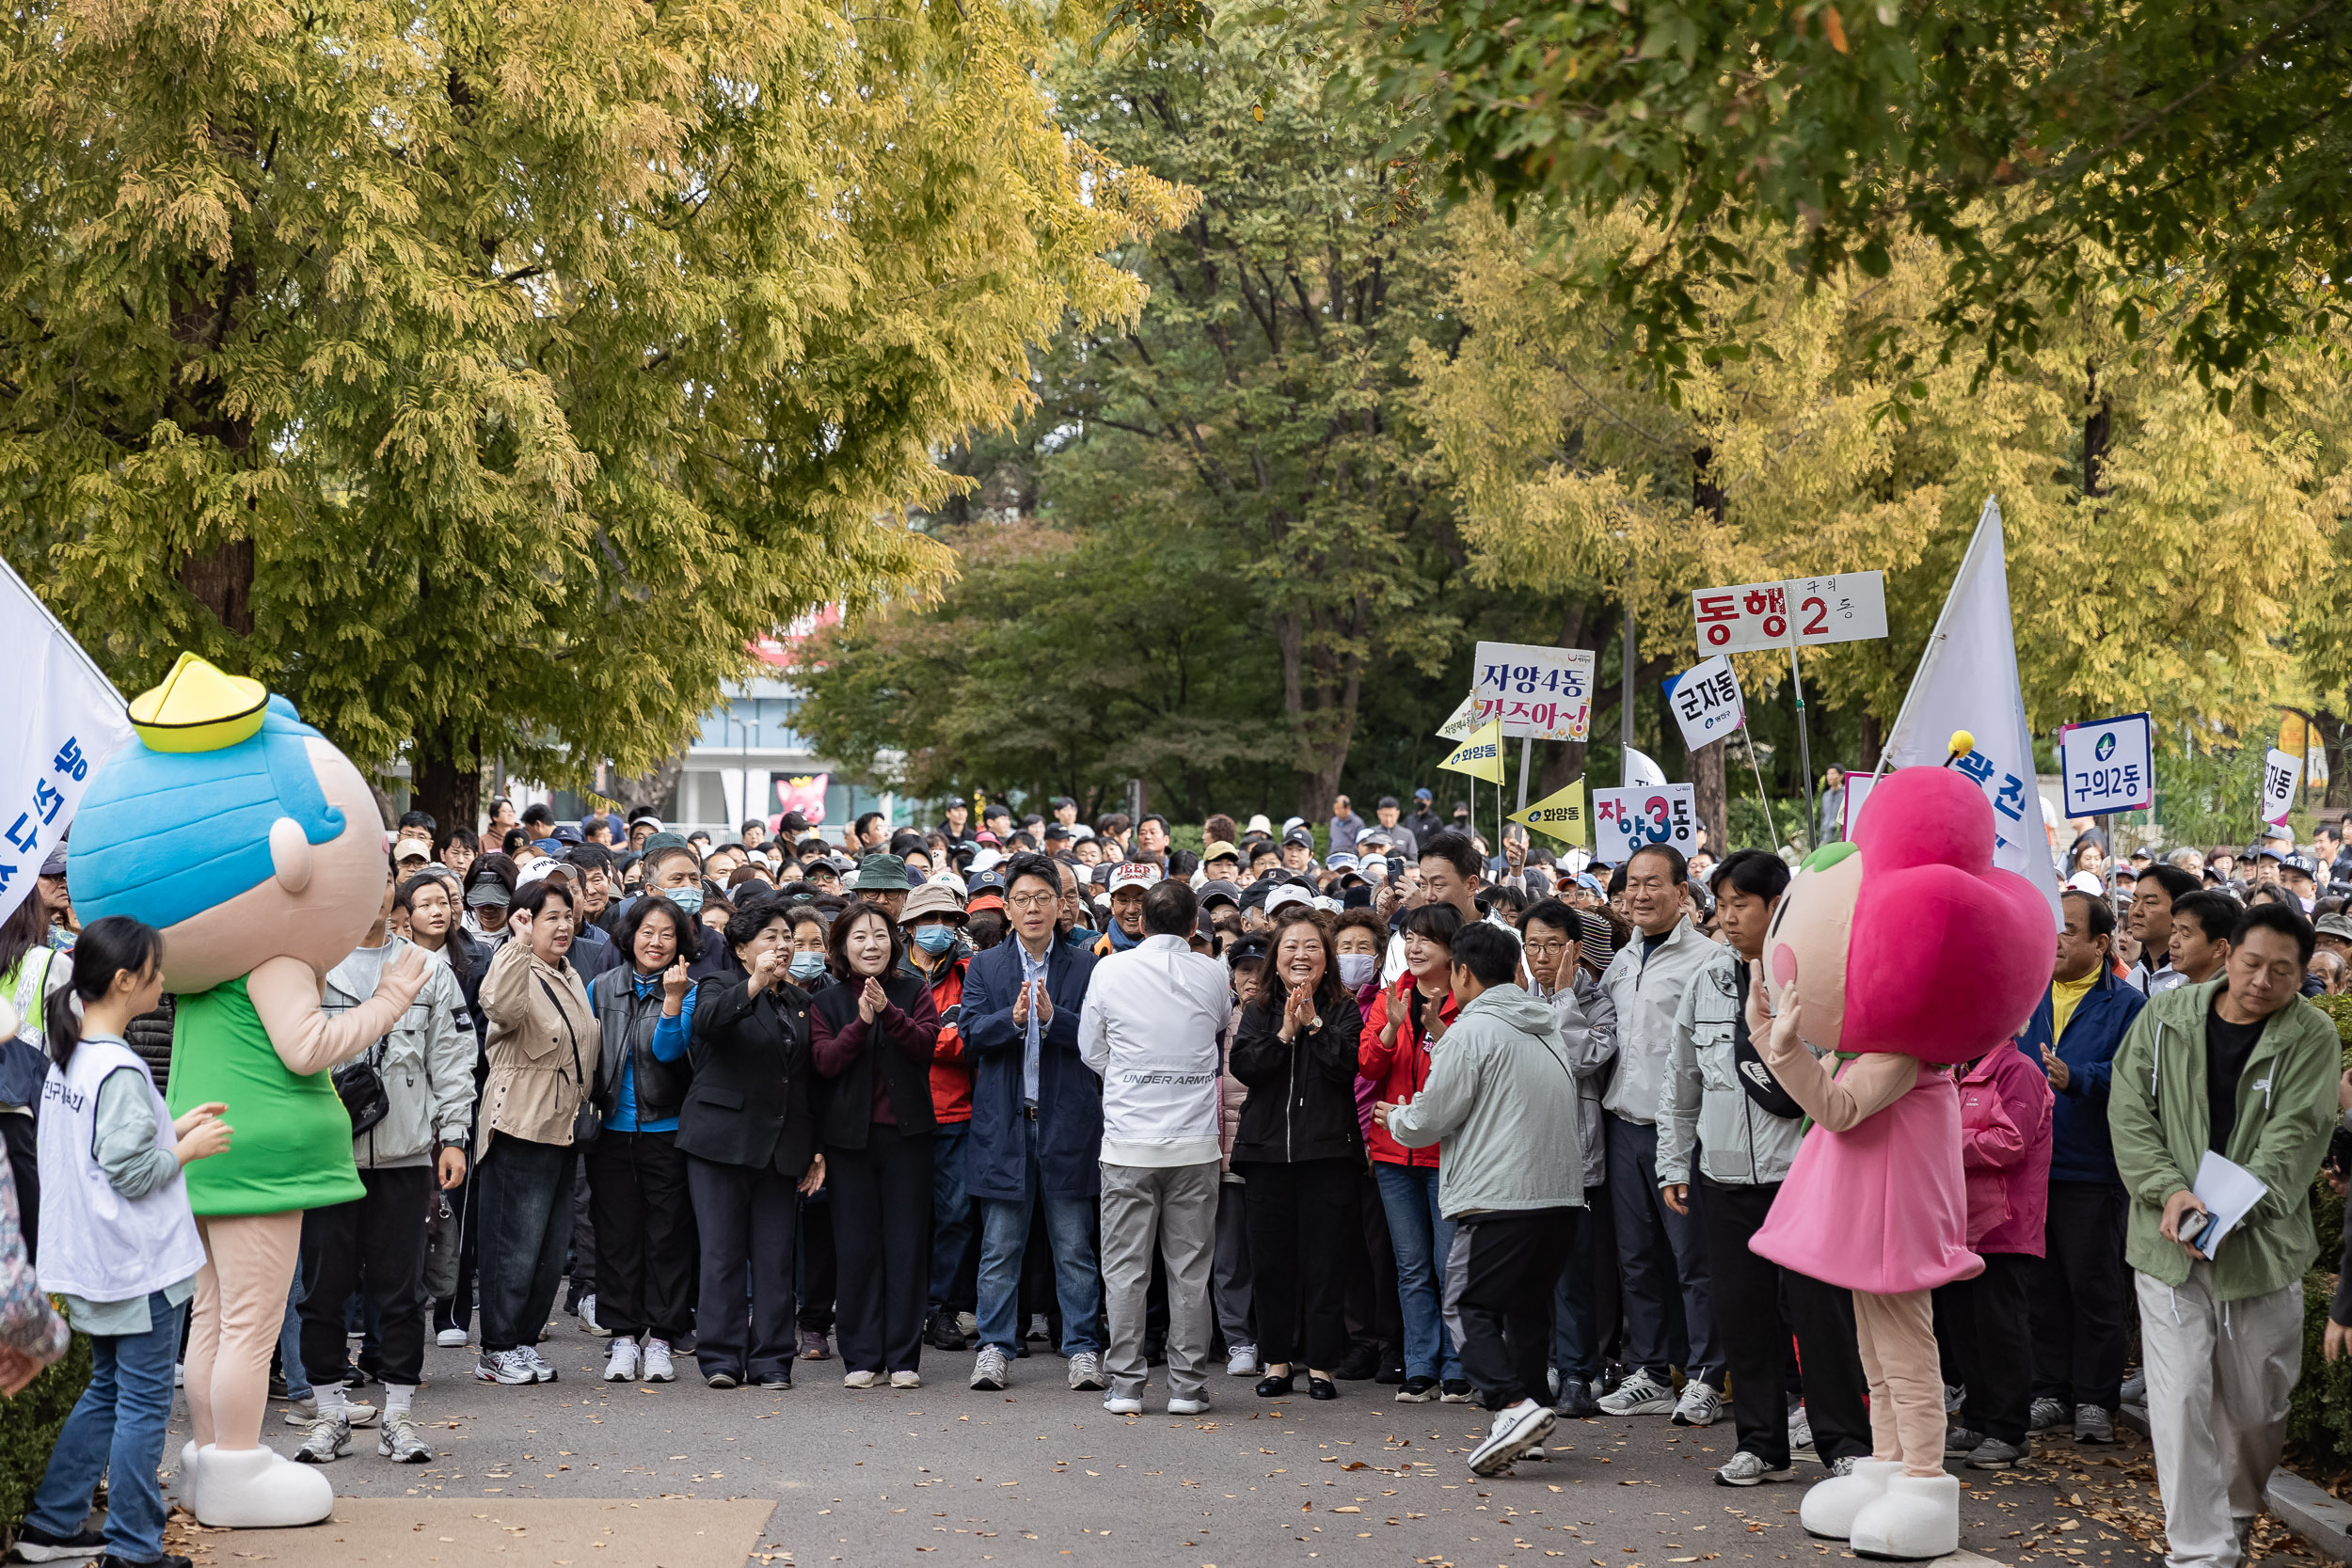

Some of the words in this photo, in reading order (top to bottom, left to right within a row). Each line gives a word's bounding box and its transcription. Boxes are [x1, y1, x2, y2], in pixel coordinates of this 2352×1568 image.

[1696, 587, 1787, 646] 동행
[1801, 596, 1829, 636] 2
[1480, 663, 1586, 698] 자양4동
[1677, 669, 1736, 722] 군자동
[1461, 743, 1497, 762] 화양동
[2074, 764, 2141, 802] 구의2동
[1543, 806, 1580, 822] 화양동
[1597, 795, 1691, 851] 자양3동
[532, 859, 559, 872] PING
[1117, 863, 1151, 877] JEEP
[1122, 1074, 1173, 1085] UNDER
[1749, 1062, 1772, 1084] NIKE
